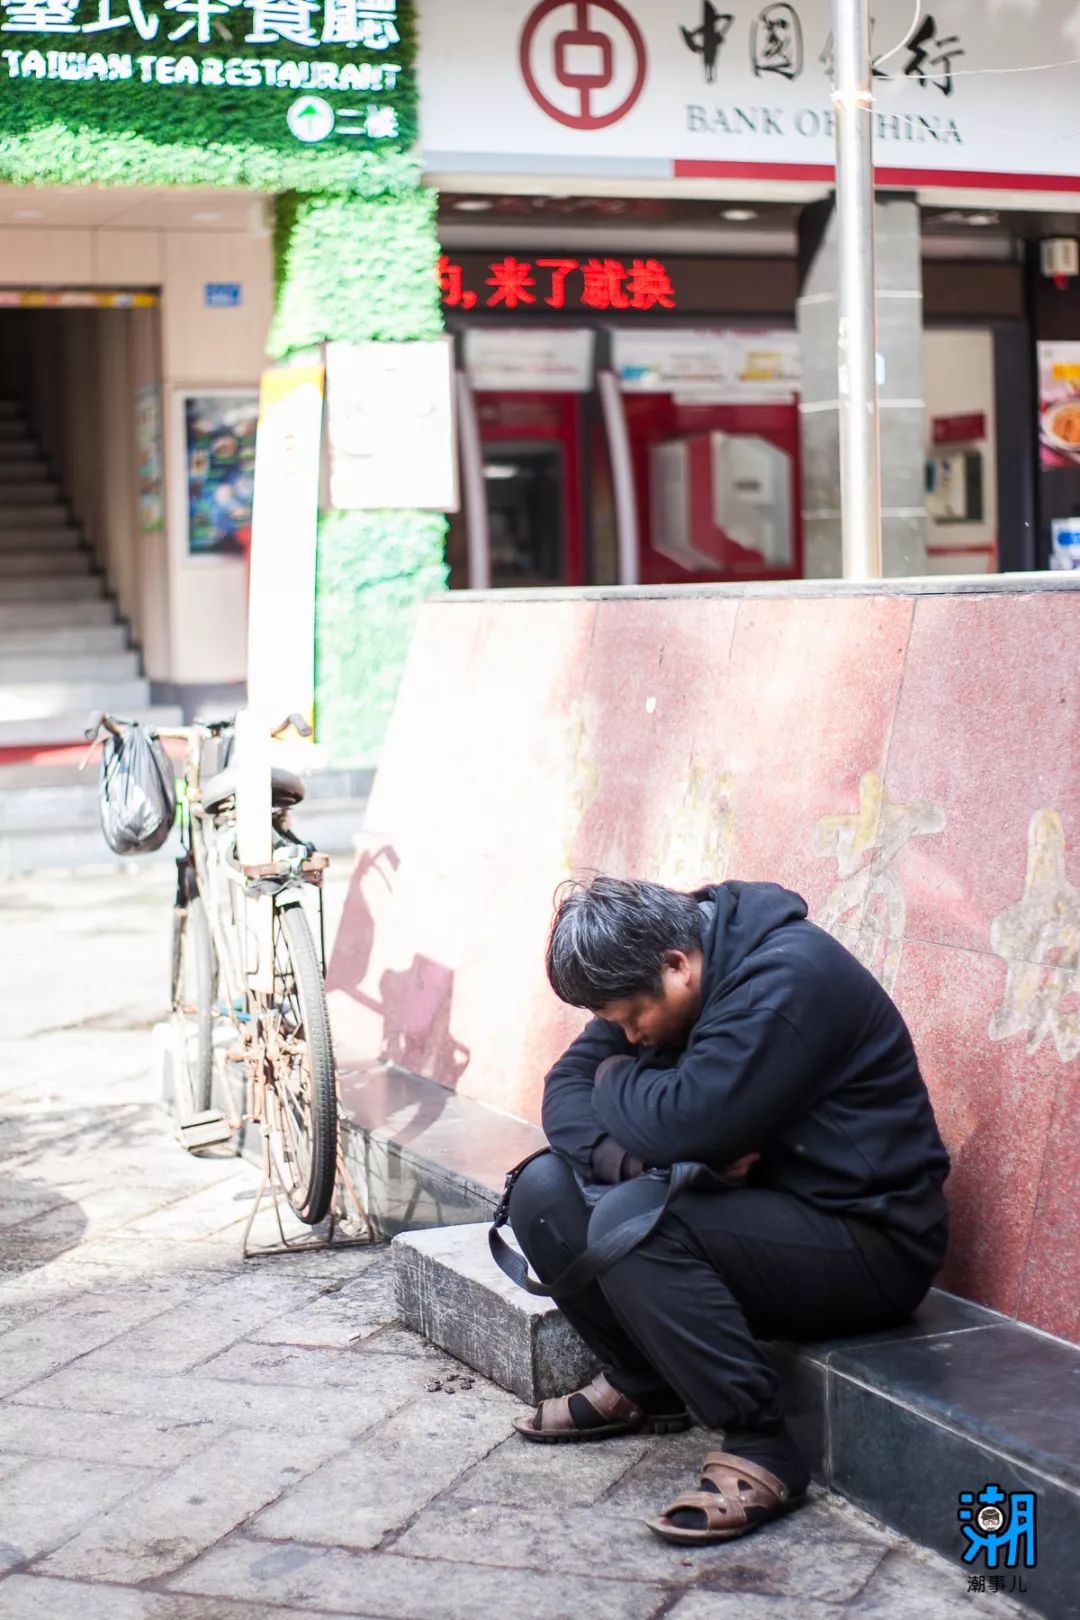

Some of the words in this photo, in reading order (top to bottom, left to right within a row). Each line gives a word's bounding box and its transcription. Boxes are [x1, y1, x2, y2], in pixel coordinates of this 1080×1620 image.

[2, 50, 132, 81] TAIWAN
[136, 55, 200, 84] TEA
[201, 57, 402, 91] RESTAURANT
[685, 104, 784, 136] BANK
[876, 112, 964, 145] HINA
